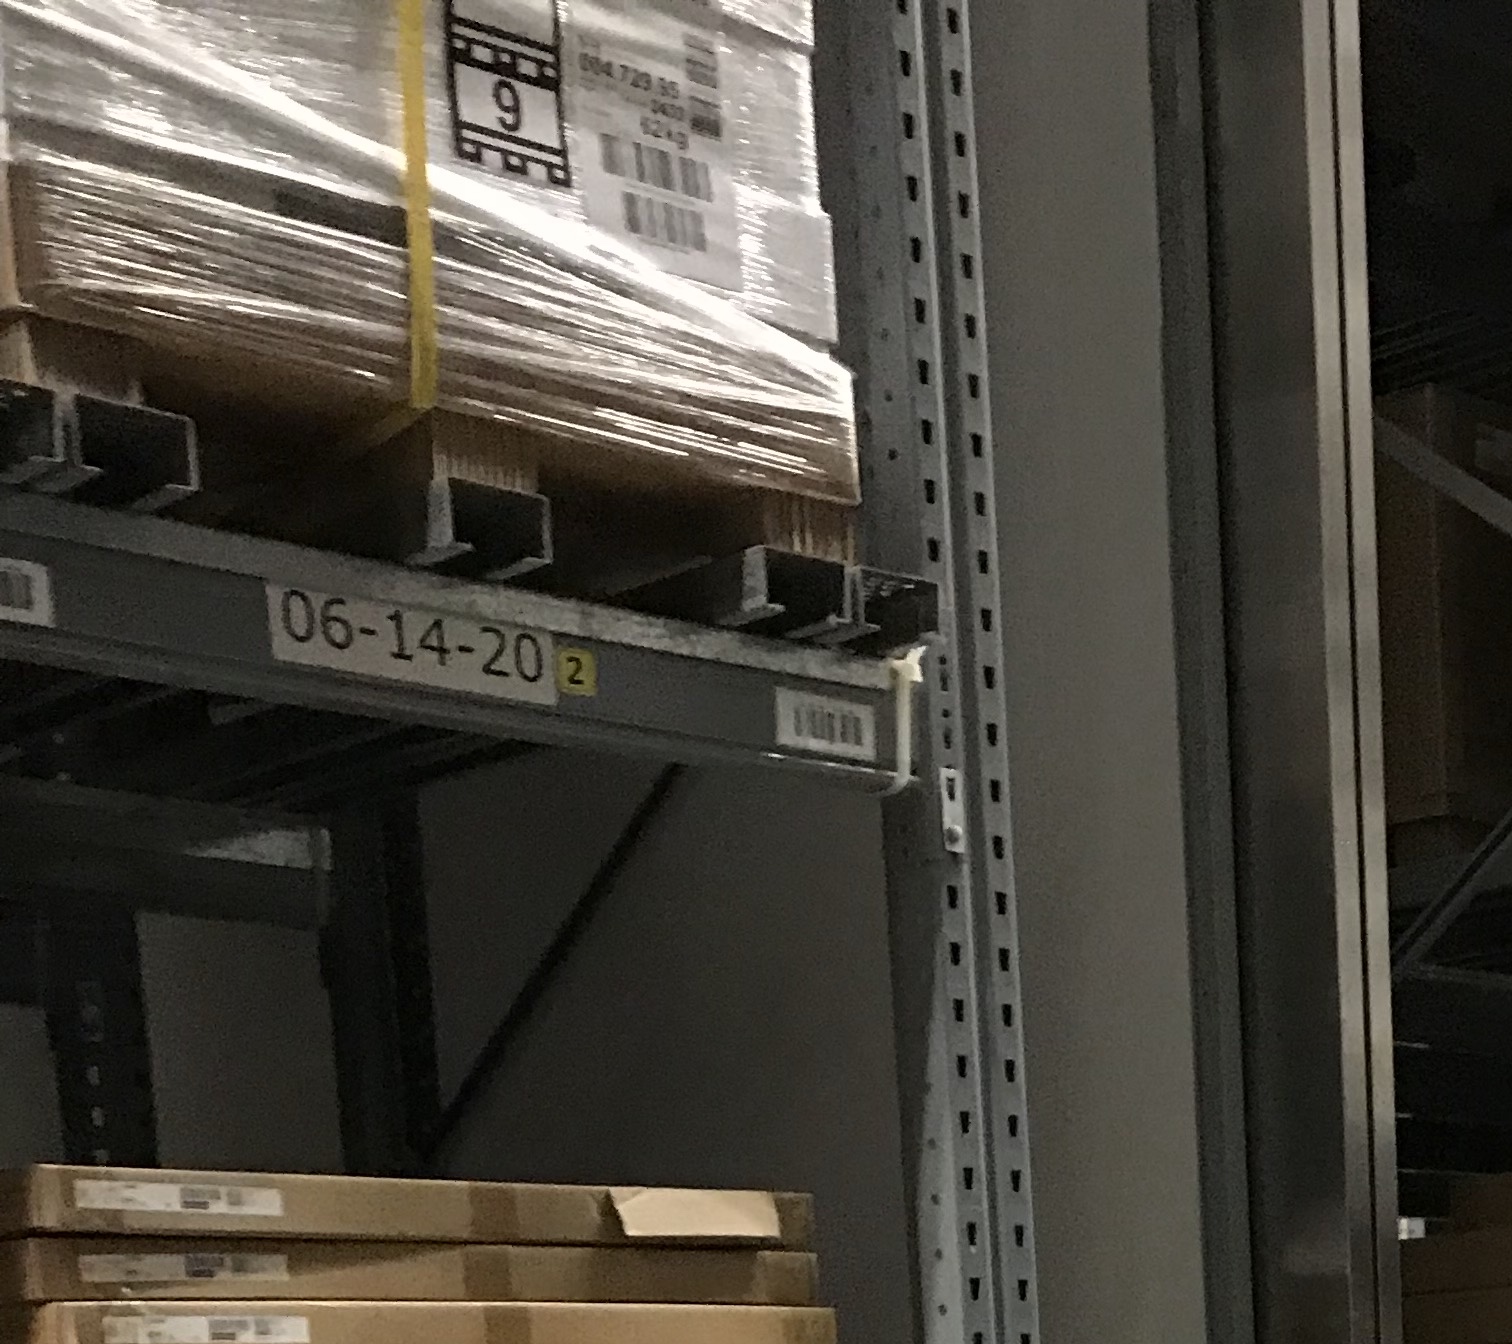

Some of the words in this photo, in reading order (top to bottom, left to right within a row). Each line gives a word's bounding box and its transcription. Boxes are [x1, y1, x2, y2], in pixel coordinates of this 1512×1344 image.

[492, 77, 522, 132] 9
[281, 588, 543, 683] 06-14-20
[565, 655, 586, 685] 2
